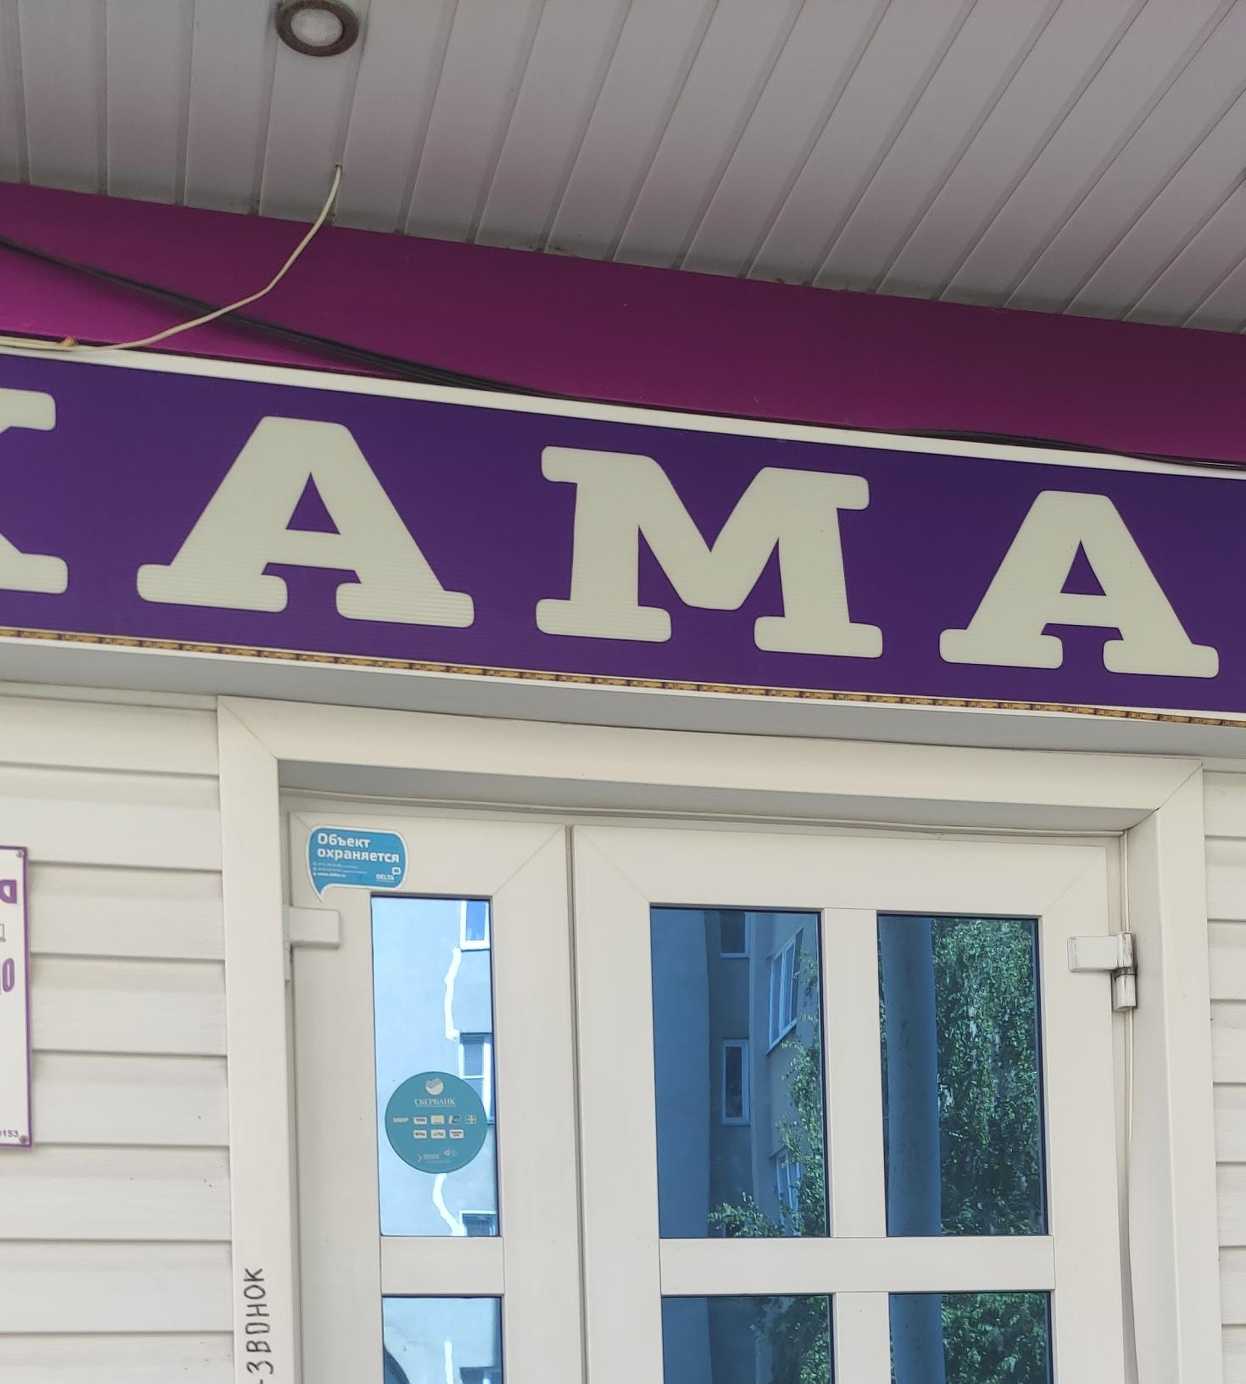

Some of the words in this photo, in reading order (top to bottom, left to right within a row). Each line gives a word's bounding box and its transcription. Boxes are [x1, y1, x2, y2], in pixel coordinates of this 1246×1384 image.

[0, 387, 1219, 679] АМА
[317, 832, 370, 848] Объект
[317, 848, 400, 863] охраняется
[243, 1268, 274, 1375] ЗВОНОК
